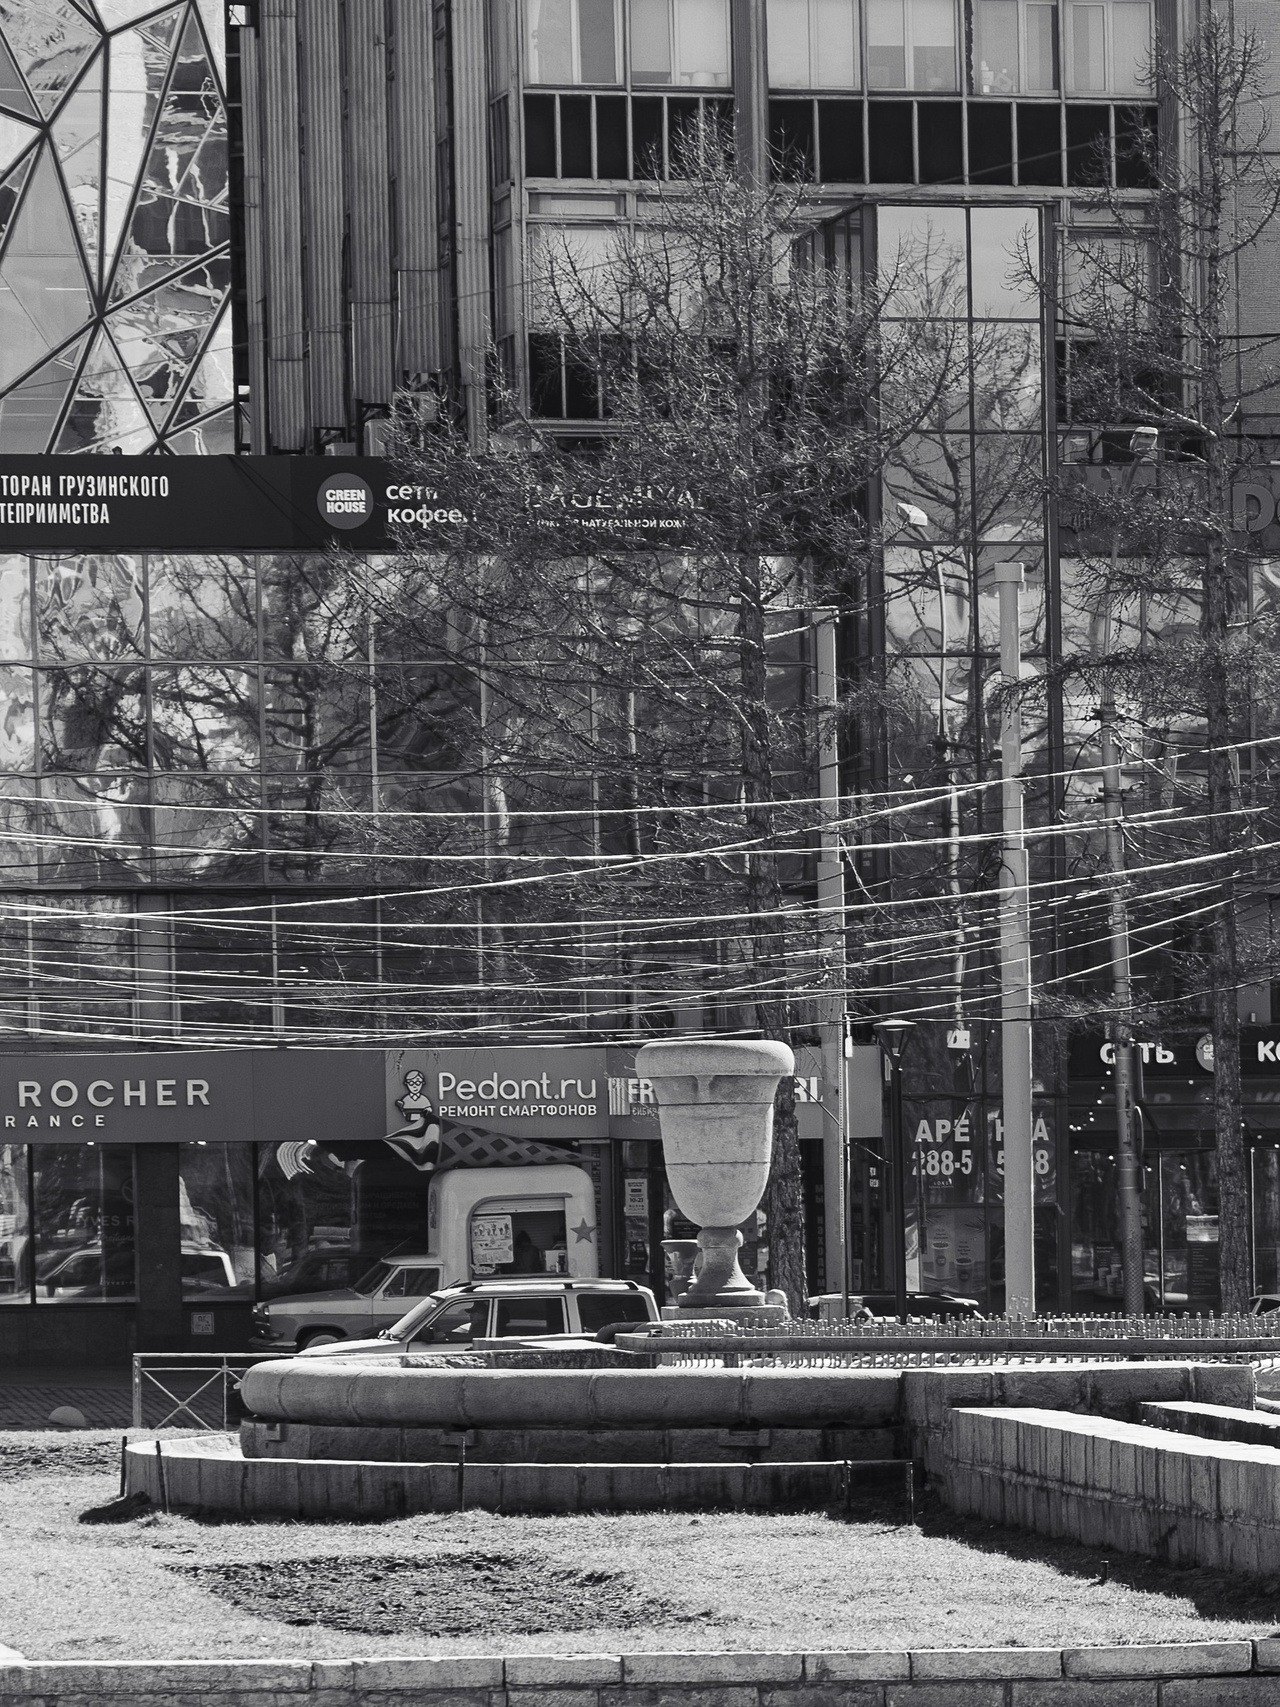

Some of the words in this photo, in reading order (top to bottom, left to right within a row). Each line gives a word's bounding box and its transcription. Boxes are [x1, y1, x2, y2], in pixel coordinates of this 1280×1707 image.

[0, 475, 51, 496] ТОРАН
[59, 475, 169, 497] ГРУЗИНСКОГО
[325, 489, 366, 501] GREEN
[0, 503, 110, 525] ТЕПРИИМСТВА
[326, 501, 367, 513] HOUSE
[1100, 1042, 1175, 1064] сть
[18, 1079, 211, 1108] ROCHER
[438, 1071, 597, 1100] Pedant.ru
[5, 1115, 105, 1127] RANCE
[439, 1105, 496, 1118] РЕМОНТ
[499, 1104, 598, 1117] СМАРТФОНОВ
